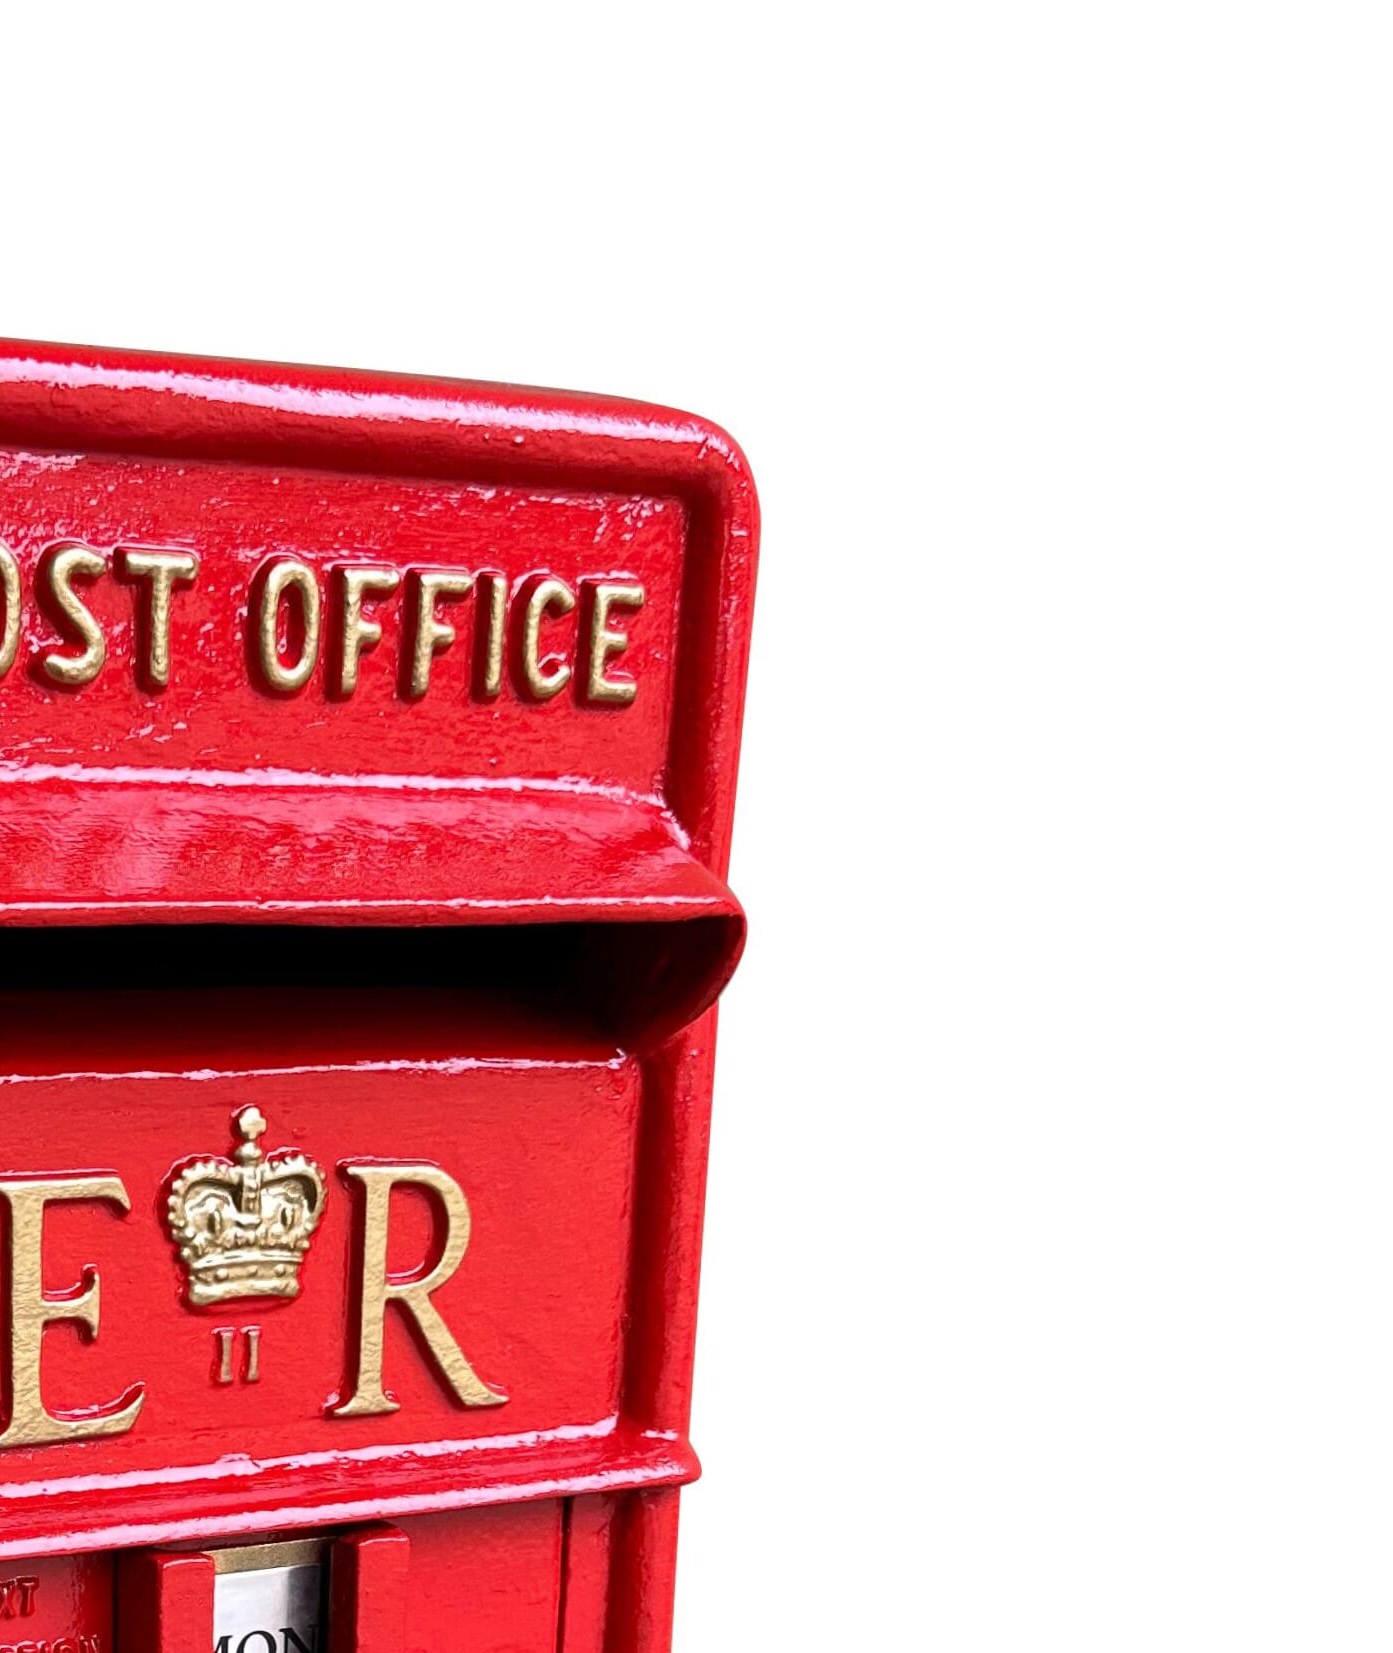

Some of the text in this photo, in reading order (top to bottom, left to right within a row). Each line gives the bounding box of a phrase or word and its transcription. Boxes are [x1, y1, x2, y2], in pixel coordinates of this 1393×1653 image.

[250, 553, 646, 704] OFFICE
[211, 1326, 261, 1384] II
[326, 1160, 509, 1417] R
